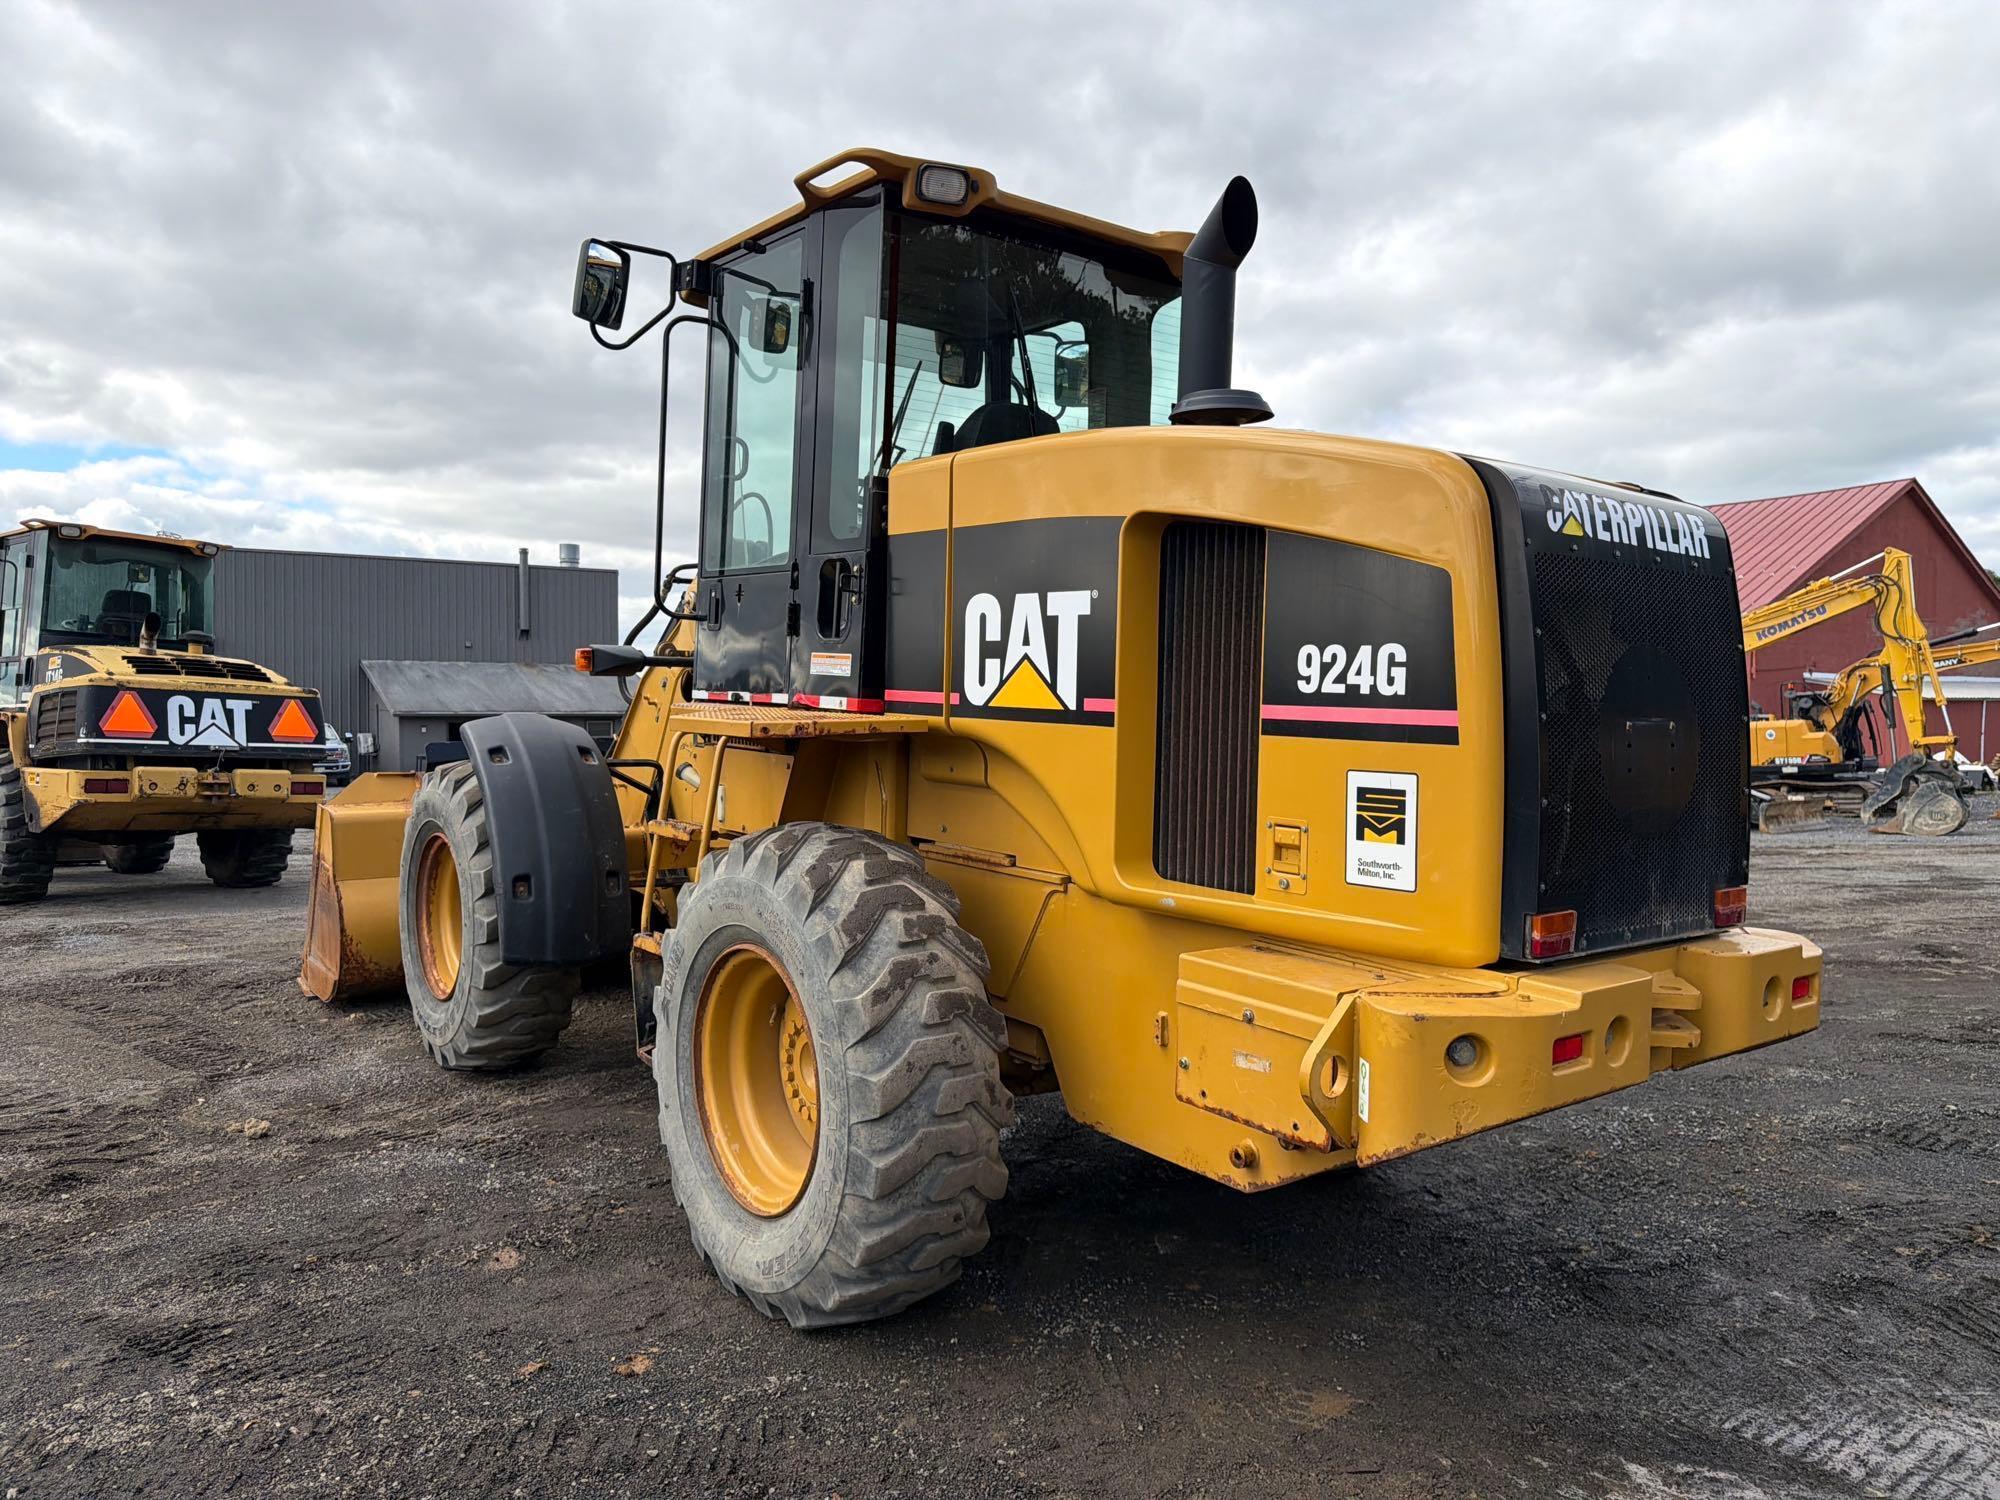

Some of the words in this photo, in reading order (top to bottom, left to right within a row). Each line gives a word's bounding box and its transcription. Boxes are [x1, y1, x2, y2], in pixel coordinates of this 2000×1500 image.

[1539, 484, 1710, 559] CATERPILLAR
[1756, 604, 1828, 641] KOMATSU
[1297, 643, 1407, 696] 924G
[167, 695, 252, 747] CAT
[1357, 857, 1403, 871] Southworth-
[1357, 867, 1382, 880] Milton,
[1382, 870, 1397, 881] Inc.
